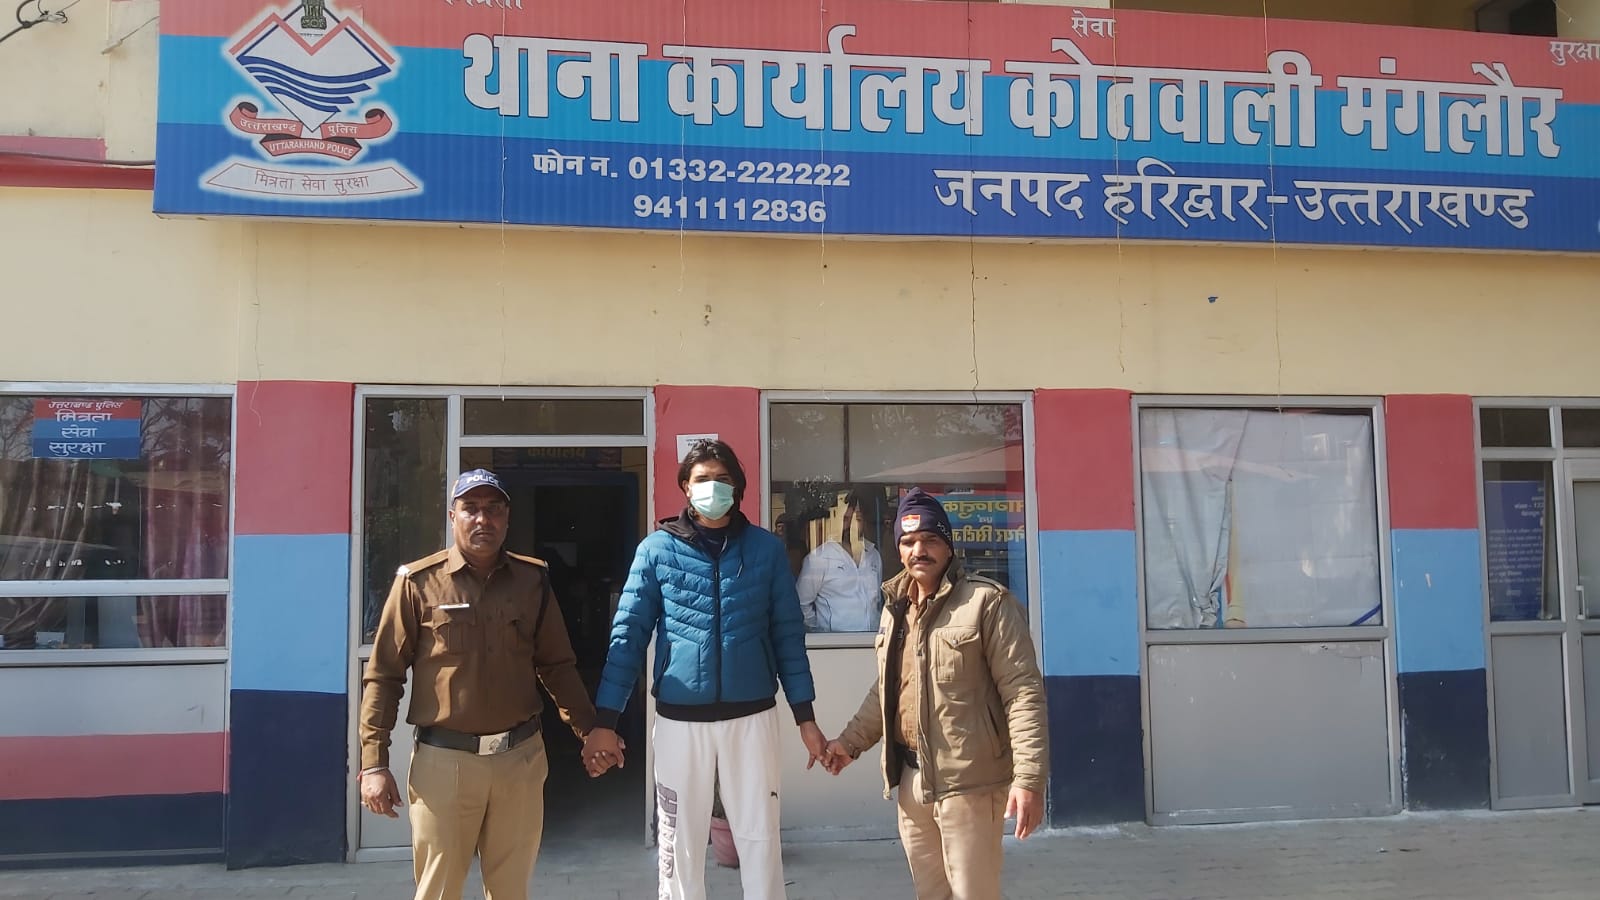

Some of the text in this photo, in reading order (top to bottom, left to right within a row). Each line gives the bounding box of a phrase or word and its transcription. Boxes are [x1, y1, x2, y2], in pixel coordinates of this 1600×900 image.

[1071, 8, 1116, 38] सेवा
[463, 24, 1564, 159] थाना कार्यालय कोतवाली मंगलौर
[239, 118, 358, 137] उत्तराखण्ड पुलिस
[269, 141, 354, 156] UTTARAKHAND POLICE
[532, 148, 584, 177] फोन
[628, 157, 851, 187] 01332-222222
[254, 169, 370, 195] मित्रता सेवा सुरक्षा
[932, 168, 1091, 220] जनपद
[633, 194, 827, 224] 9411112836
[55, 408, 113, 422] मित्रता
[61, 424, 98, 439] सेवा
[48, 441, 107, 457] सुरक्षा
